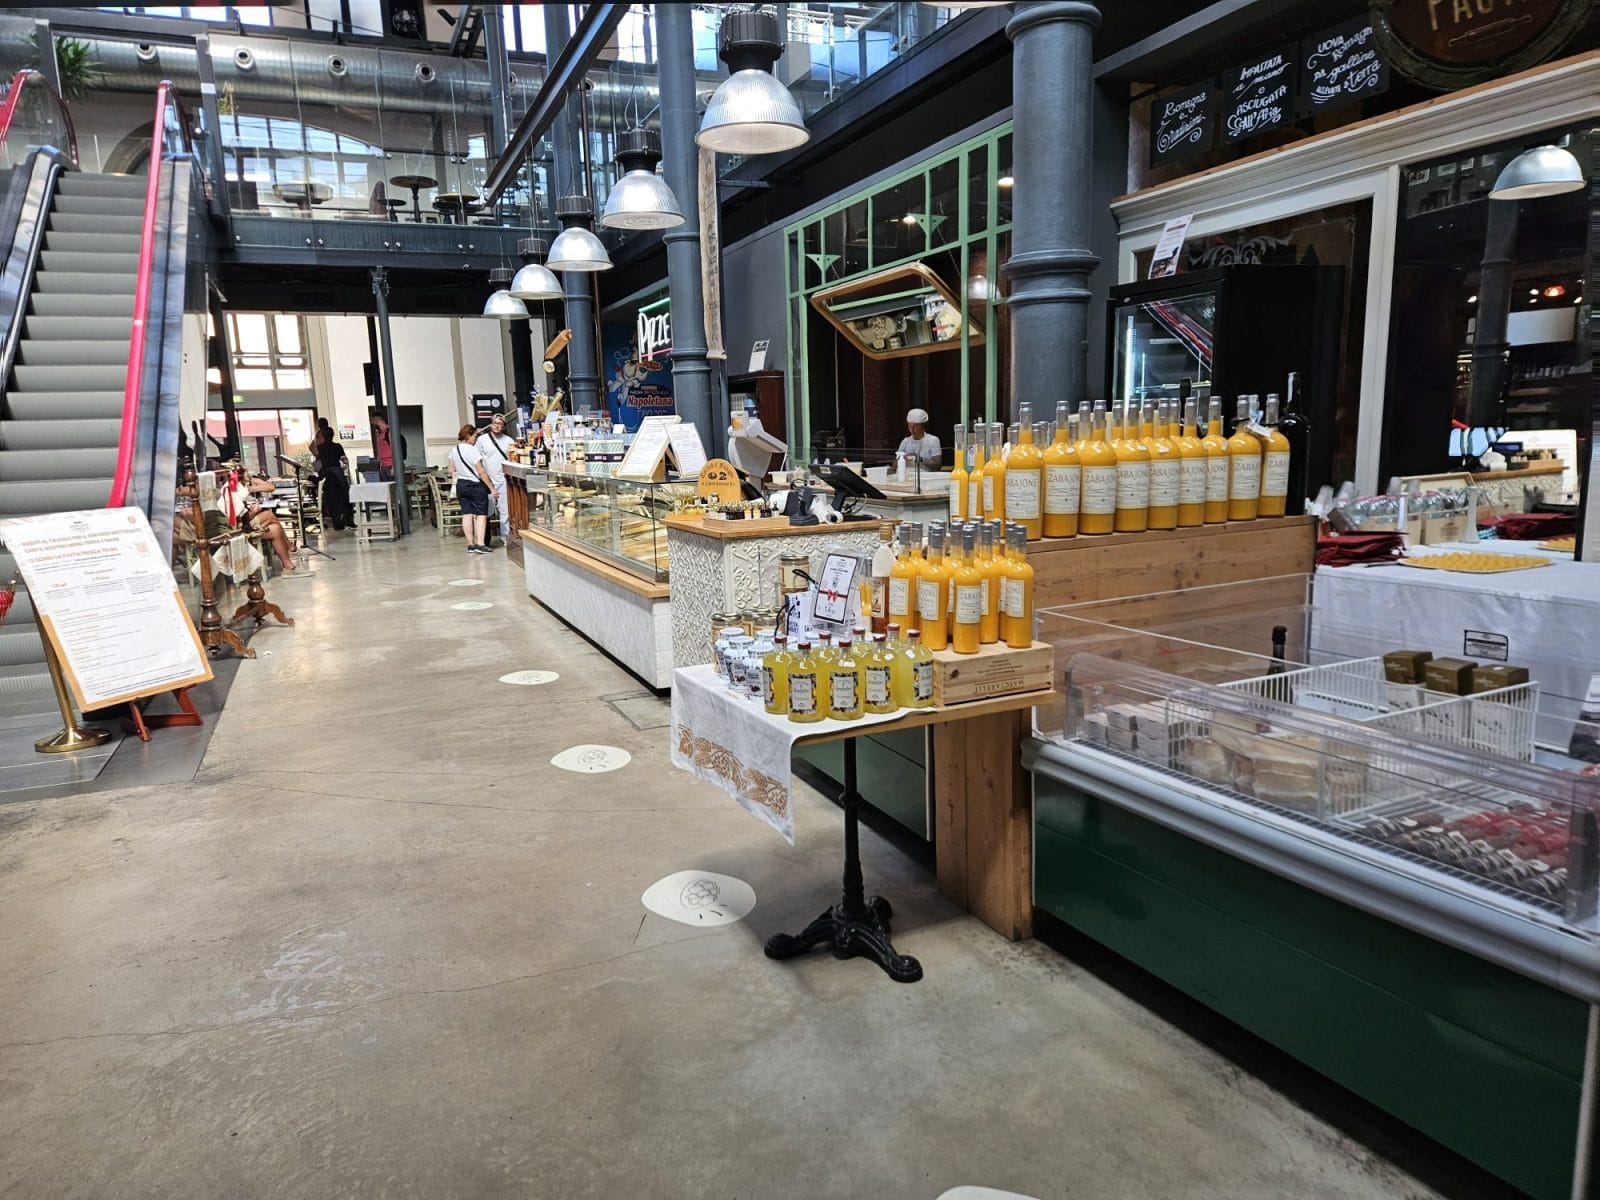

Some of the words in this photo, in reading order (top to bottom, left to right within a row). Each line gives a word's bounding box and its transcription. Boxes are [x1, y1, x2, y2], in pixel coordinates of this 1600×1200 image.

[1331, 27, 1373, 62] Romagn
[1236, 85, 1288, 116] ASCIUGATA
[626, 394, 673, 409] Napoletana
